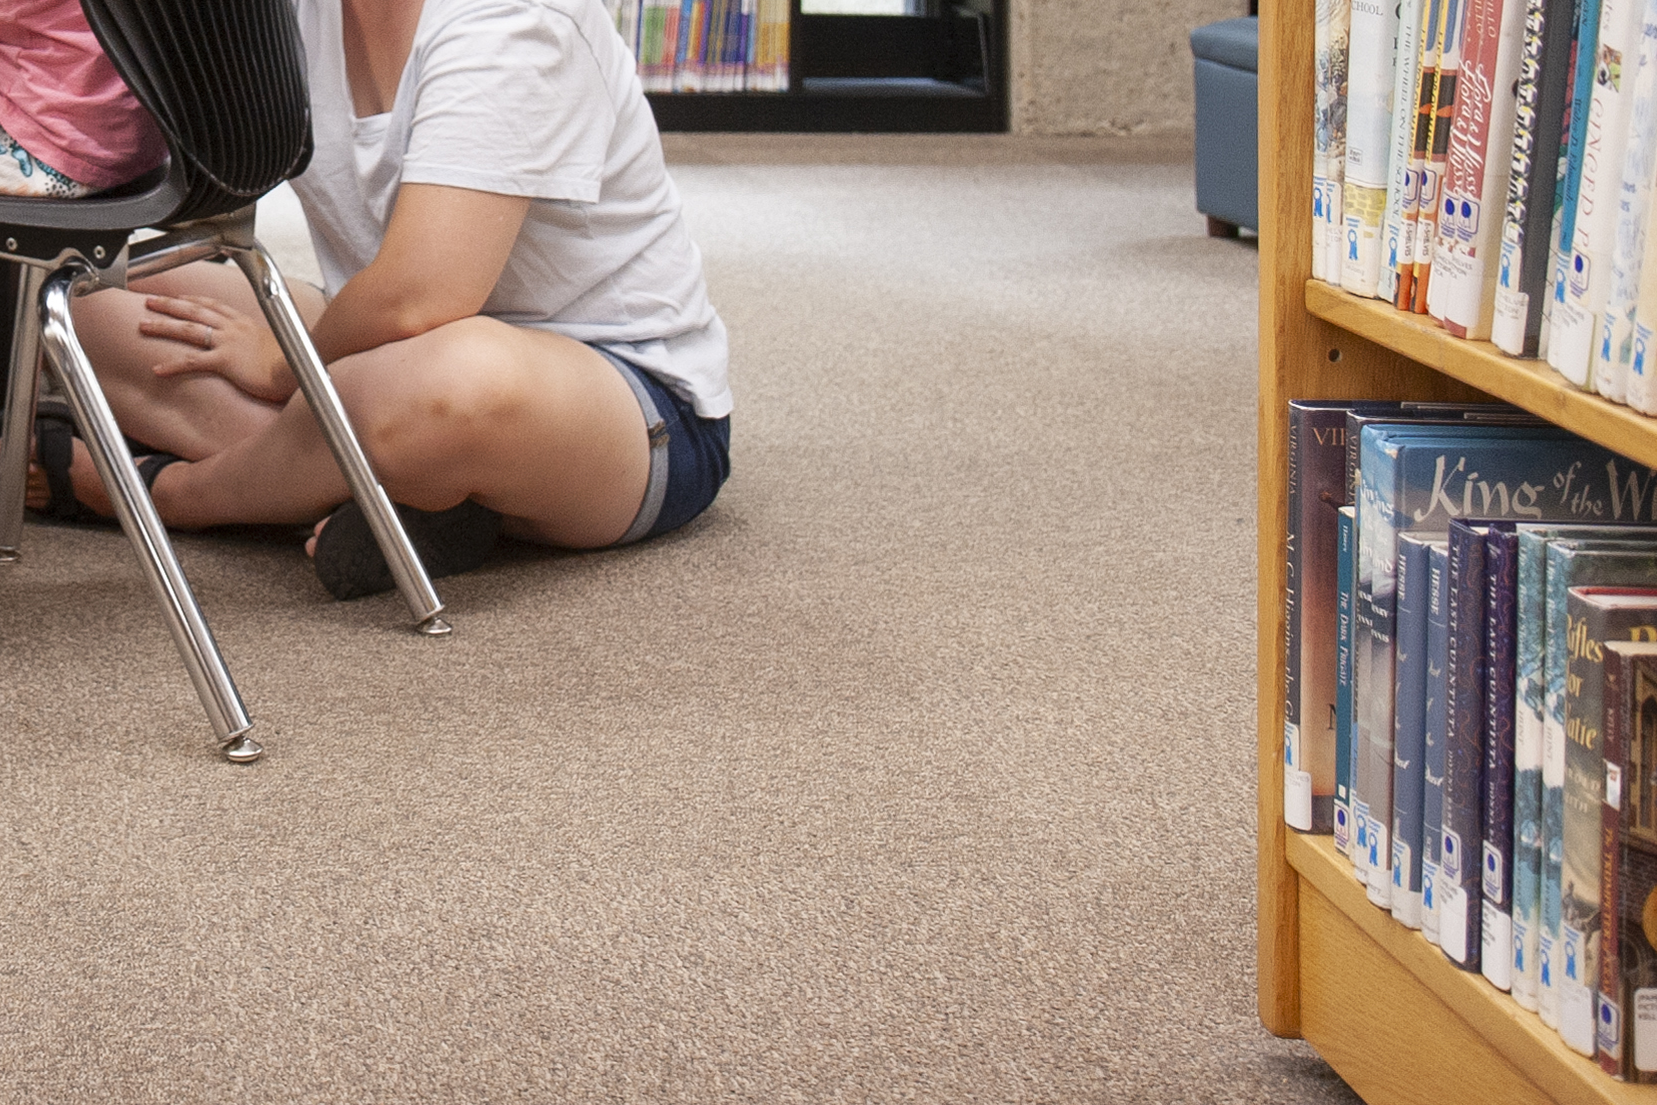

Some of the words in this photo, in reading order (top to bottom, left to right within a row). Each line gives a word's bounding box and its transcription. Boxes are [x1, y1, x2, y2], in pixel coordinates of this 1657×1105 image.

[1351, 1, 1384, 16] CHOOL
[1404, 25, 1412, 54] THE
[1400, 57, 1411, 105] WHEEL
[1456, 60, 1472, 118] Flora
[1472, 63, 1492, 122] Flora
[1398, 108, 1407, 124] ON
[1396, 135, 1406, 160] THE
[1392, 165, 1402, 218] SCHOOL
[1289, 426, 1297, 495] VIRGINIA
[1348, 435, 1357, 505] VIRGINIA
[1413, 455, 1546, 523] King
[1552, 460, 1582, 506] of
[1570, 485, 1604, 520] the
[1398, 553, 1407, 601] HESSE
[1451, 544, 1460, 580] THE
[1431, 567, 1441, 616] HESSE
[1449, 587, 1459, 631] LAST
[1489, 573, 1497, 609] THE
[1340, 614, 1349, 640] DARK
[1489, 616, 1497, 662] LAST
[1339, 645, 1349, 686] FRIGATE
[1446, 637, 1457, 738] CUENTISTA
[1488, 667, 1497, 769] CUENTISTA
[1566, 704, 1597, 750] atie
